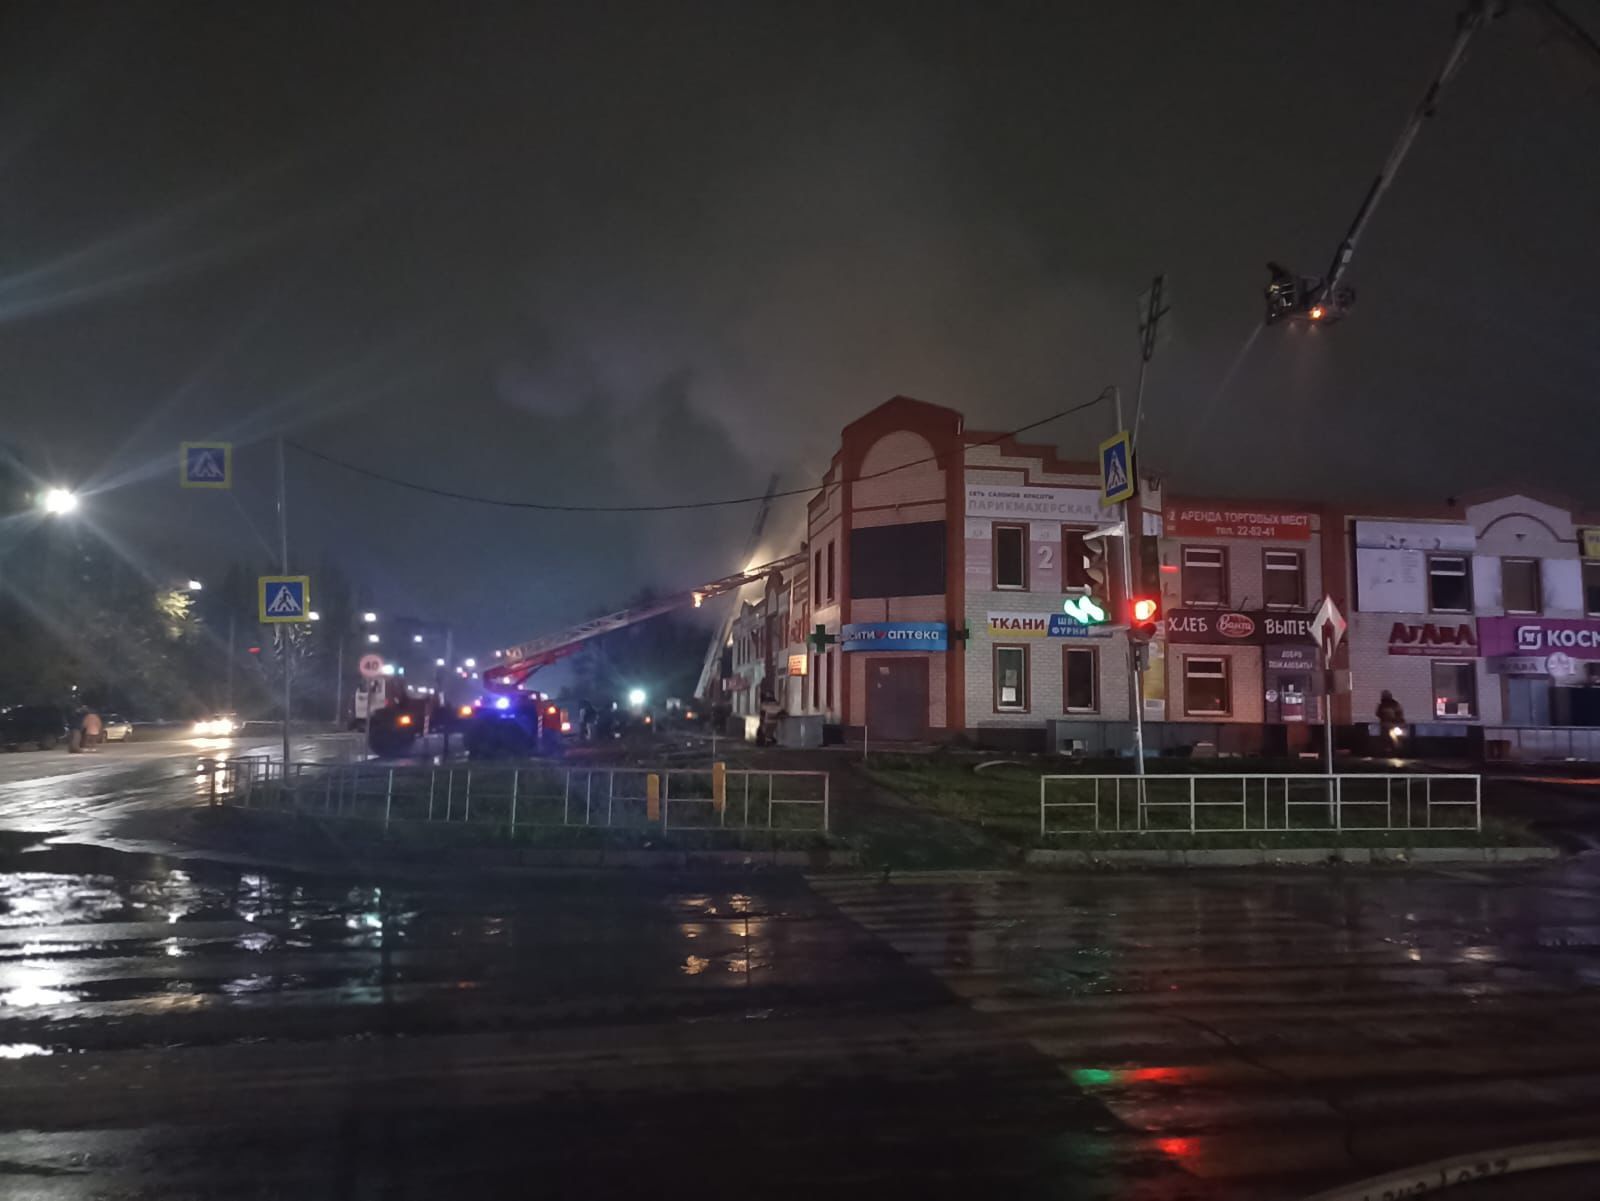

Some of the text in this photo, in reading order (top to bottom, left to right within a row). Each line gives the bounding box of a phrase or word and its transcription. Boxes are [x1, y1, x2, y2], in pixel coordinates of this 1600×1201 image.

[968, 500, 1092, 515] ПАРИКМАХЕРСКАЯ
[1180, 511, 1308, 526] АРЕНДА ТОРГОВЫХ МЕСТ
[1037, 545, 1053, 569] 2
[990, 617, 1045, 630] ТКАНИ
[1168, 617, 1208, 632] ХЛЕБ
[887, 629, 940, 640] аптека
[363, 659, 380, 671] 40
